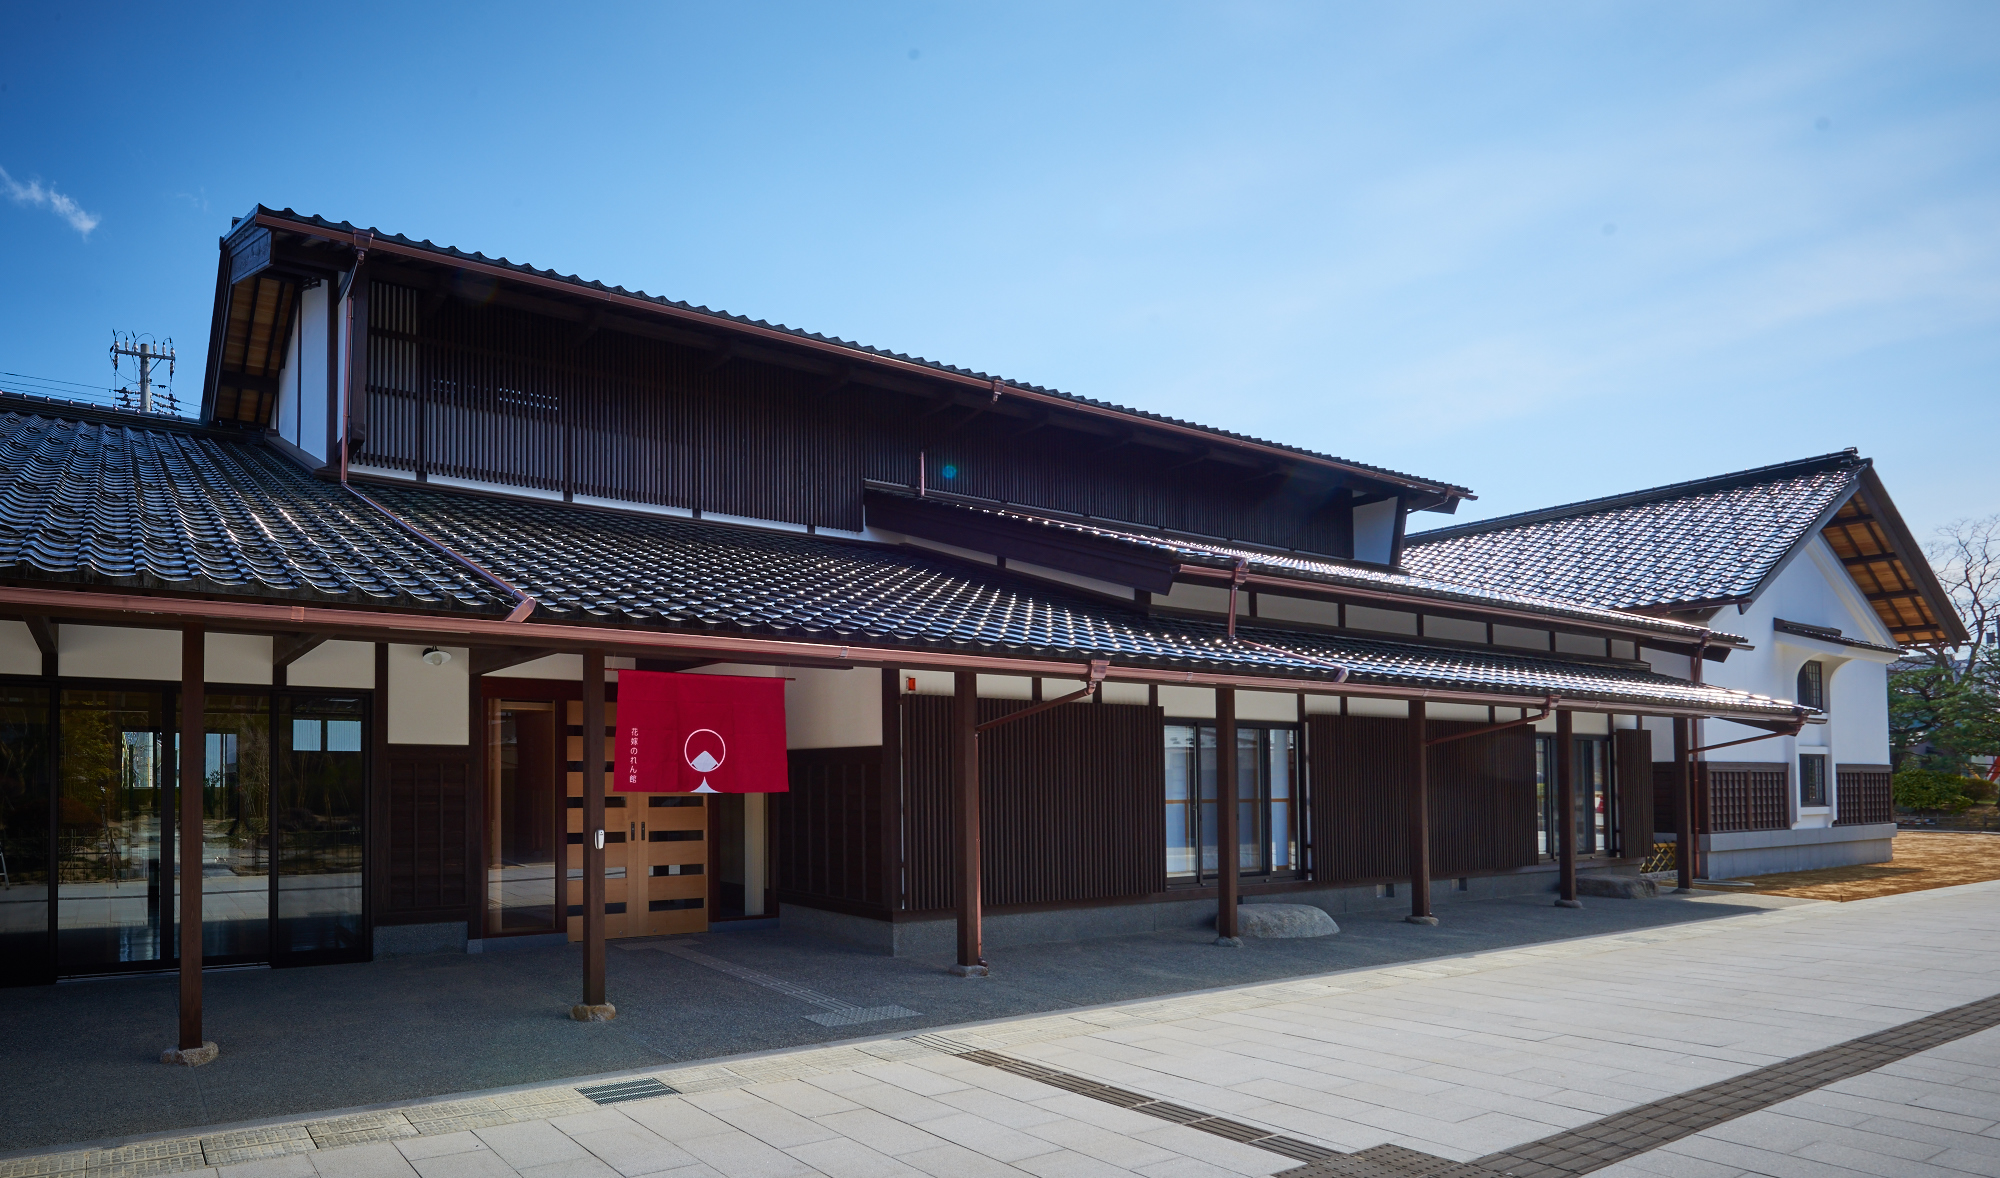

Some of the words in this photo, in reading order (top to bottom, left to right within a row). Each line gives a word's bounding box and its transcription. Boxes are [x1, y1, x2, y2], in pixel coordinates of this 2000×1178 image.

[629, 728, 639, 784] 花嫁のれん館
